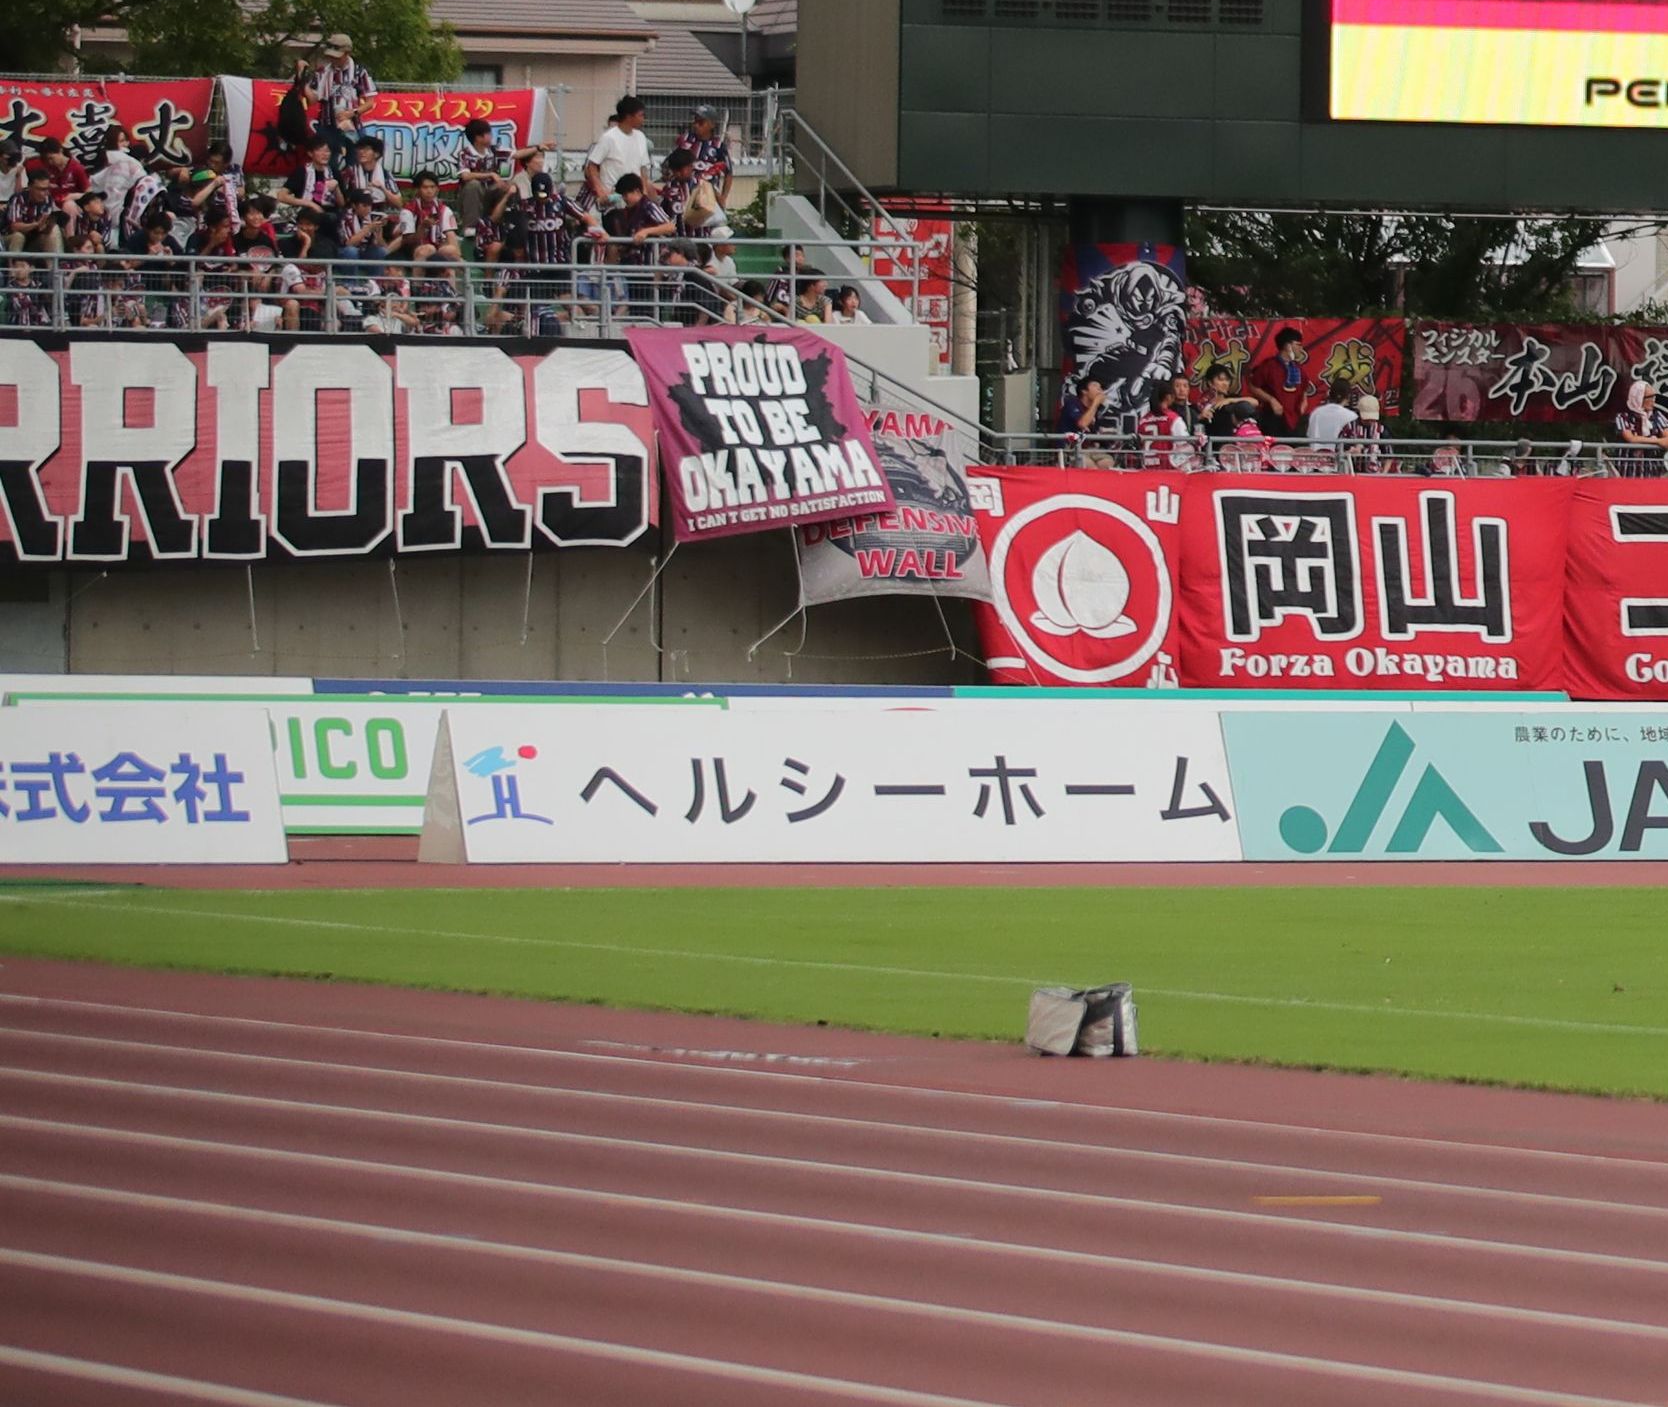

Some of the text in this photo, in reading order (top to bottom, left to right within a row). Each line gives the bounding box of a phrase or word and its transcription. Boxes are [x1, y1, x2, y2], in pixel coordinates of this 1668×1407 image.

[1421, 328, 1500, 348] フィジカル
[1421, 345, 1506, 366] モンスター
[682, 341, 808, 397] PROUD
[1413, 367, 1481, 422] 26
[704, 397, 823, 446] TO BE
[679, 439, 883, 513] OKAYAMA
[741, 506, 768, 522] GET
[770, 504, 789, 519] NO
[790, 489, 886, 516] SATISFACTION
[855, 549, 965, 580] WALL
[1213, 488, 1511, 645] 岡山
[1219, 649, 1519, 681] Forza Okayama
[272, 716, 410, 781] ICO
[0, 751, 251, 825] 式会社
[579, 754, 1232, 826] ヘルシーホーム
